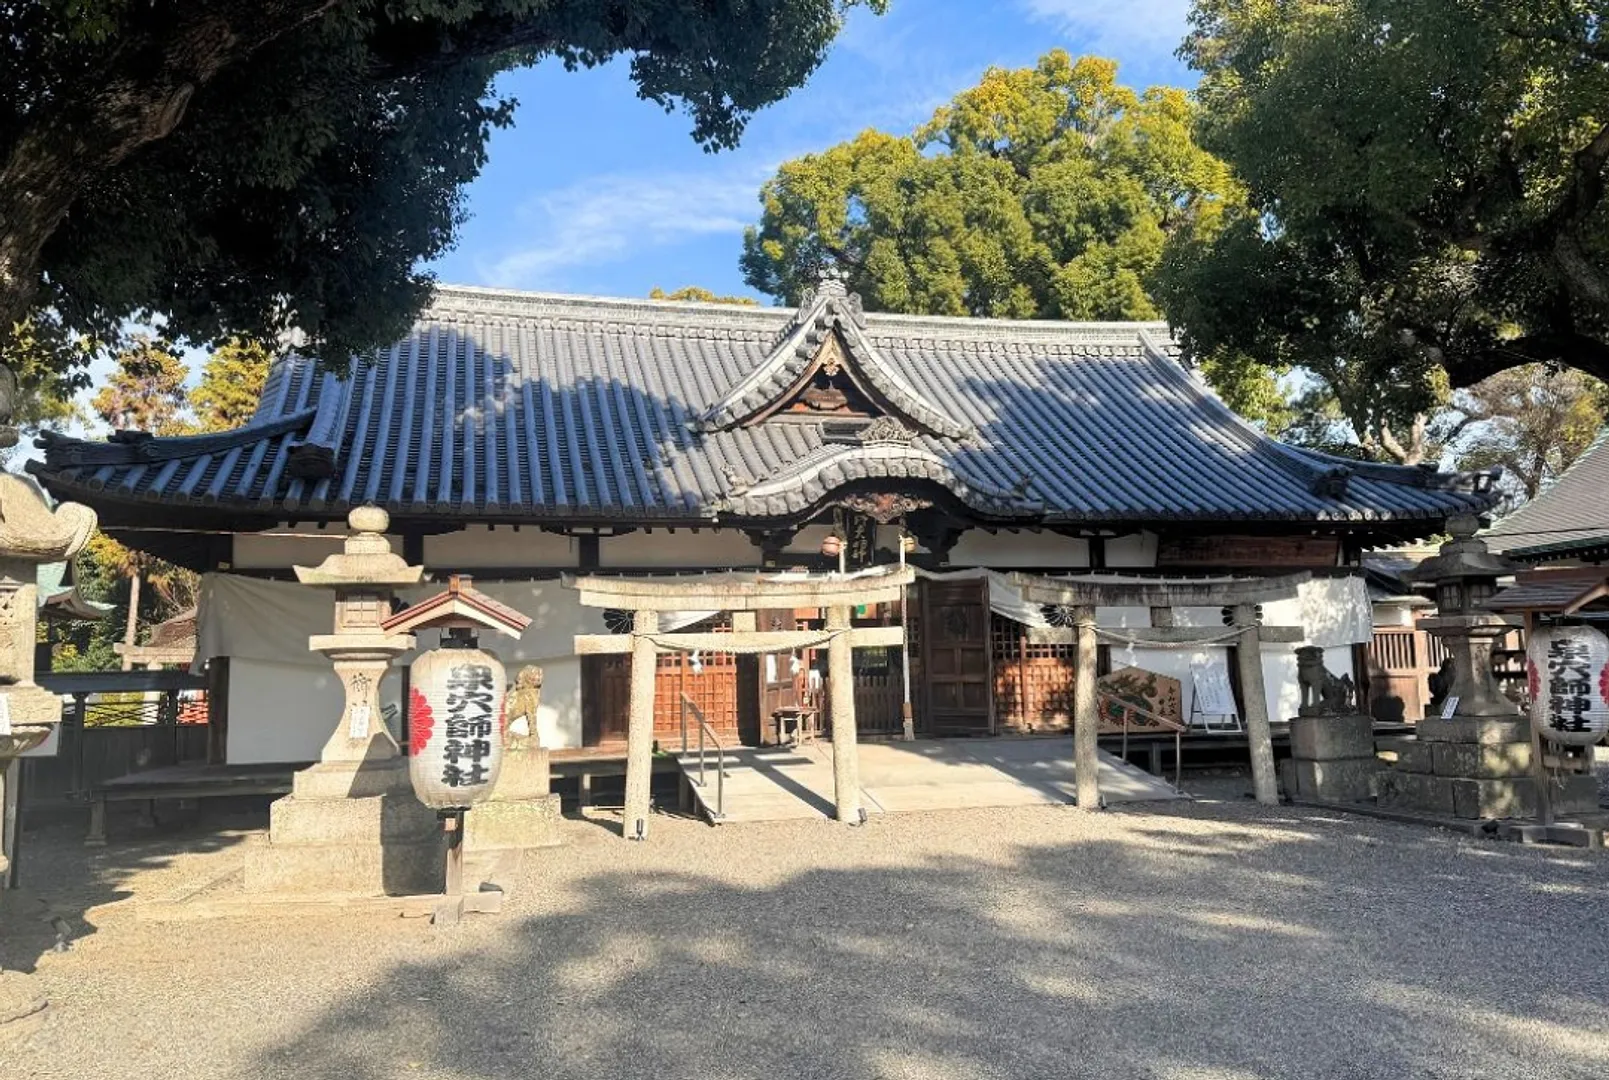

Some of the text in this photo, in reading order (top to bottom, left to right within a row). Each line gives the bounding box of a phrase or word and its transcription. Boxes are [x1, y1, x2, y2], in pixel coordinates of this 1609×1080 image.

[441, 663, 495, 787] 泉穴師神社
